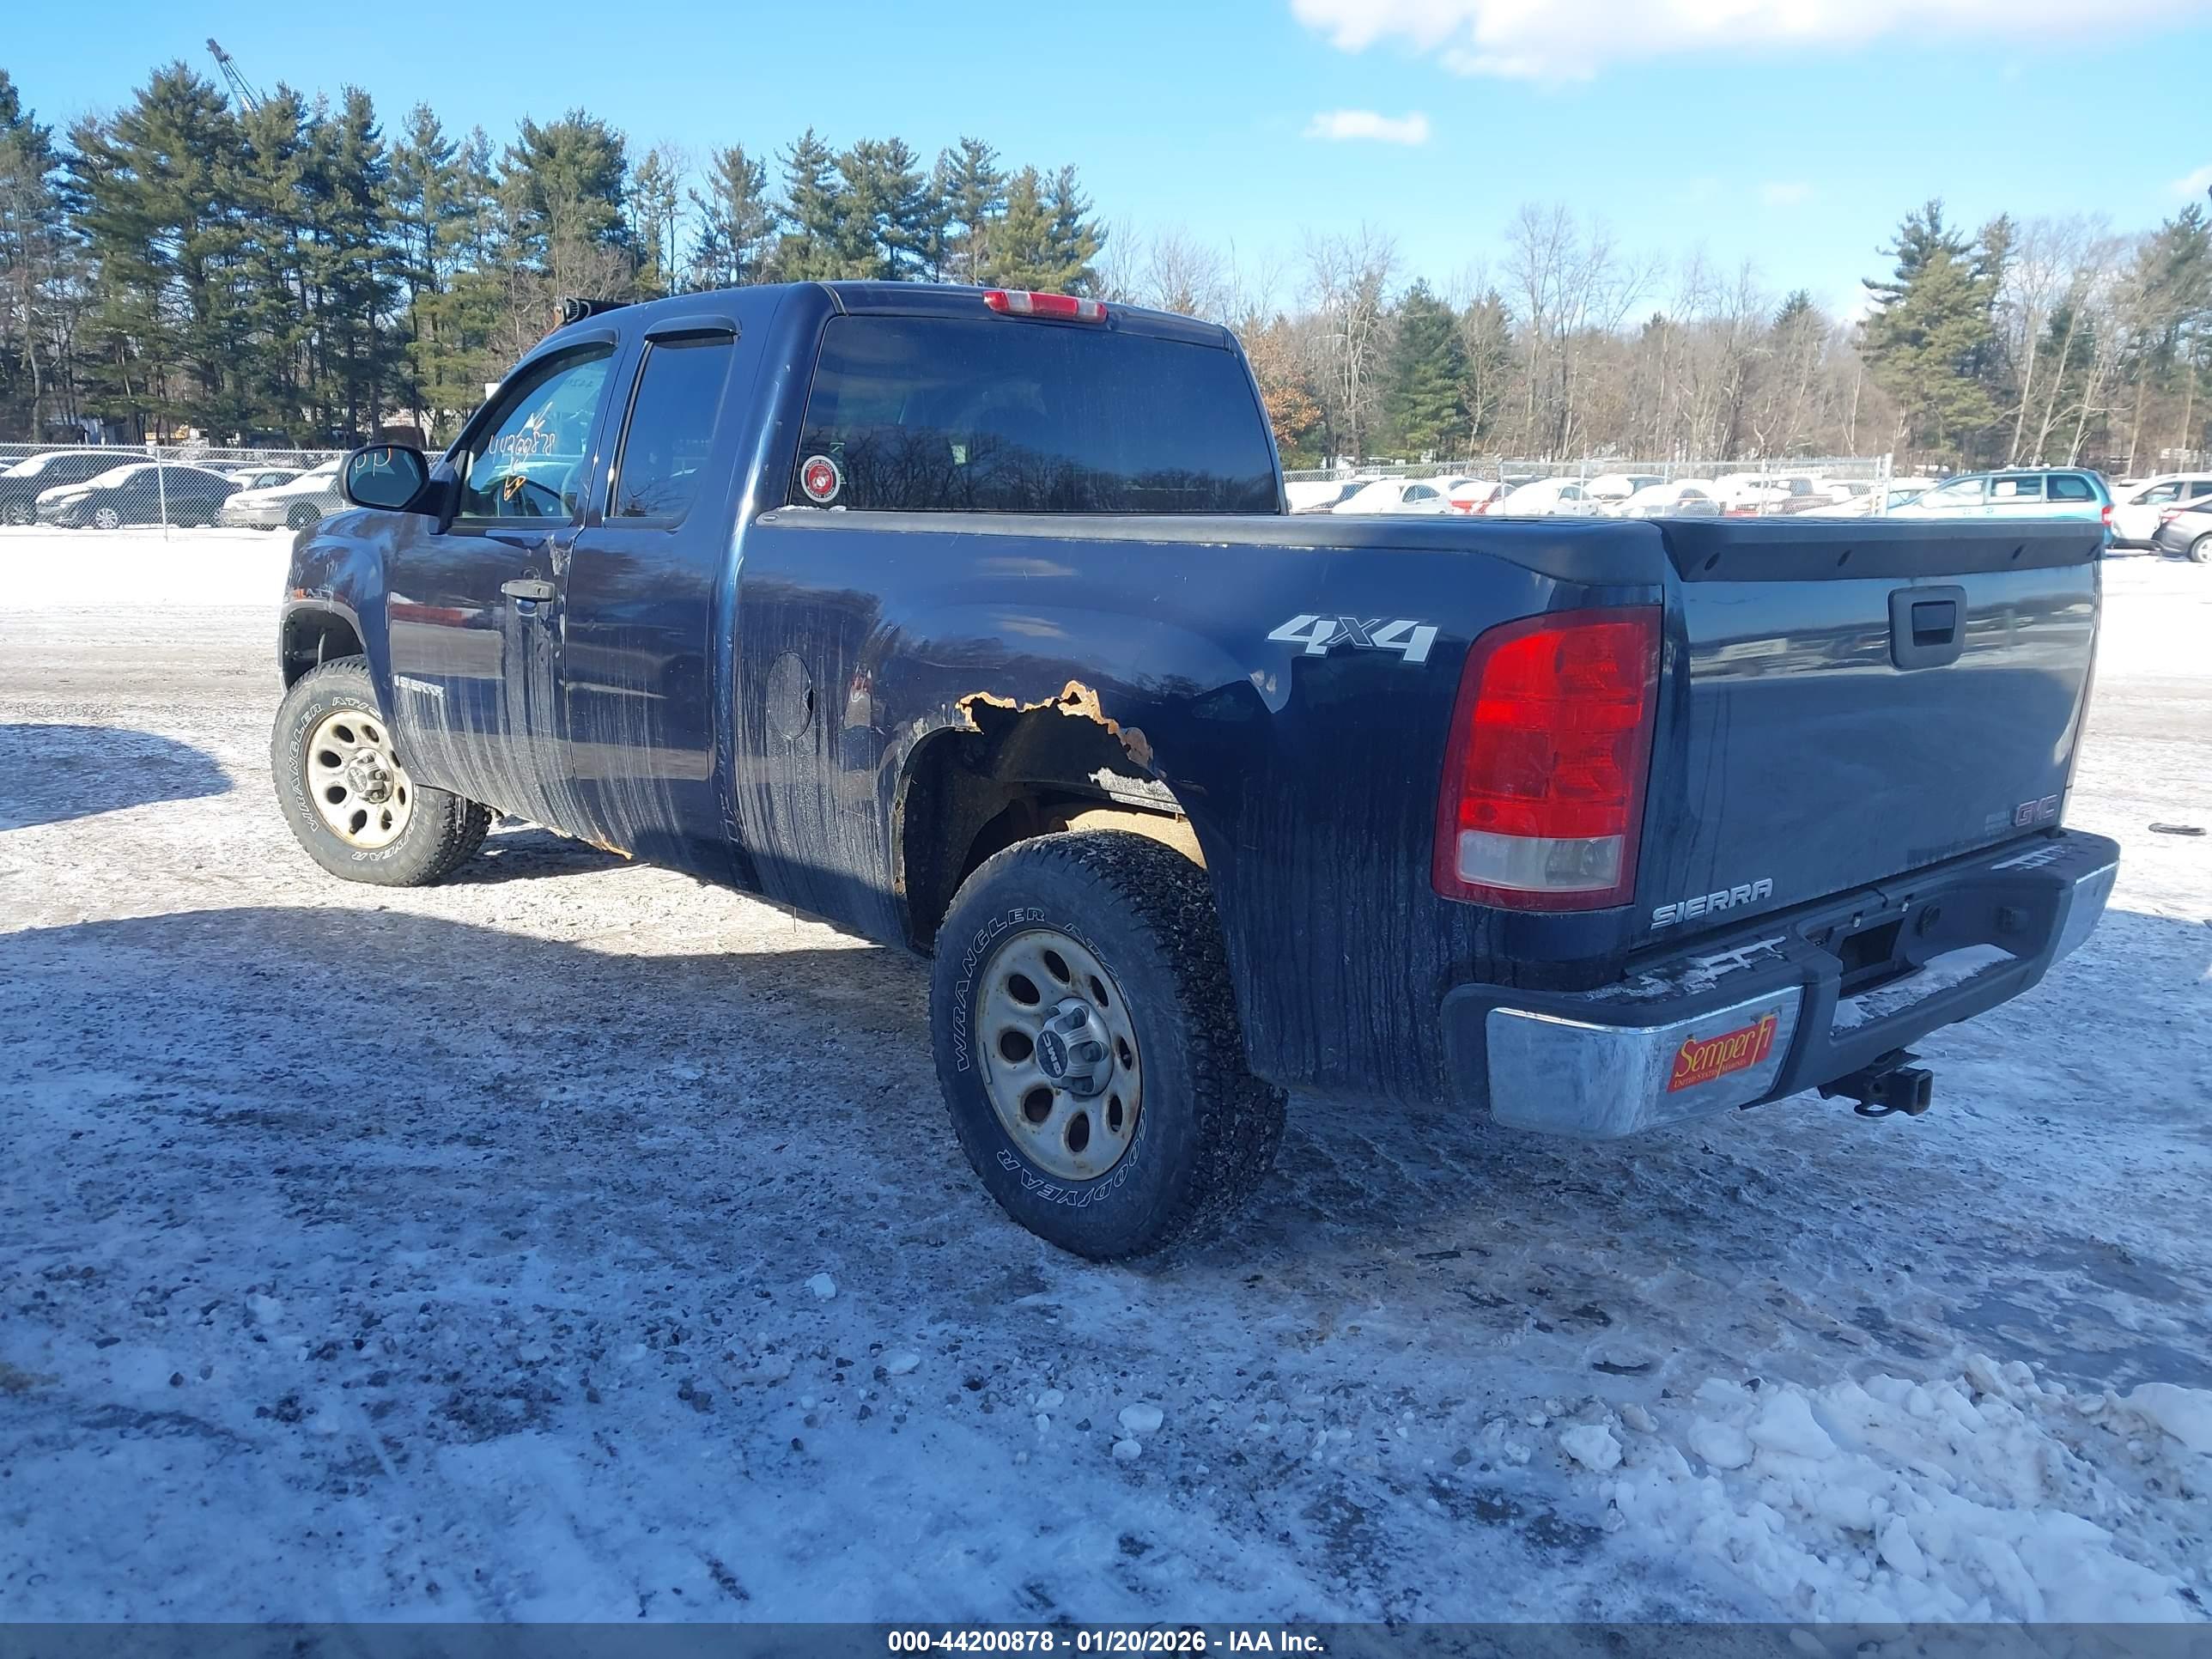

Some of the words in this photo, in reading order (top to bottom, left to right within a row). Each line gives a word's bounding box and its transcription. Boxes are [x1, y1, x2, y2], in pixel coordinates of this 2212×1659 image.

[288, 702, 323, 831] WRANGLER
[1650, 878, 1773, 930] SIERRA
[953, 907, 1045, 1073] WRANGLER
[1042, 1032, 1062, 1076] GMC
[1674, 1038, 1756, 1080] Semper
[996, 1106, 1147, 1208] GOODYEAR
